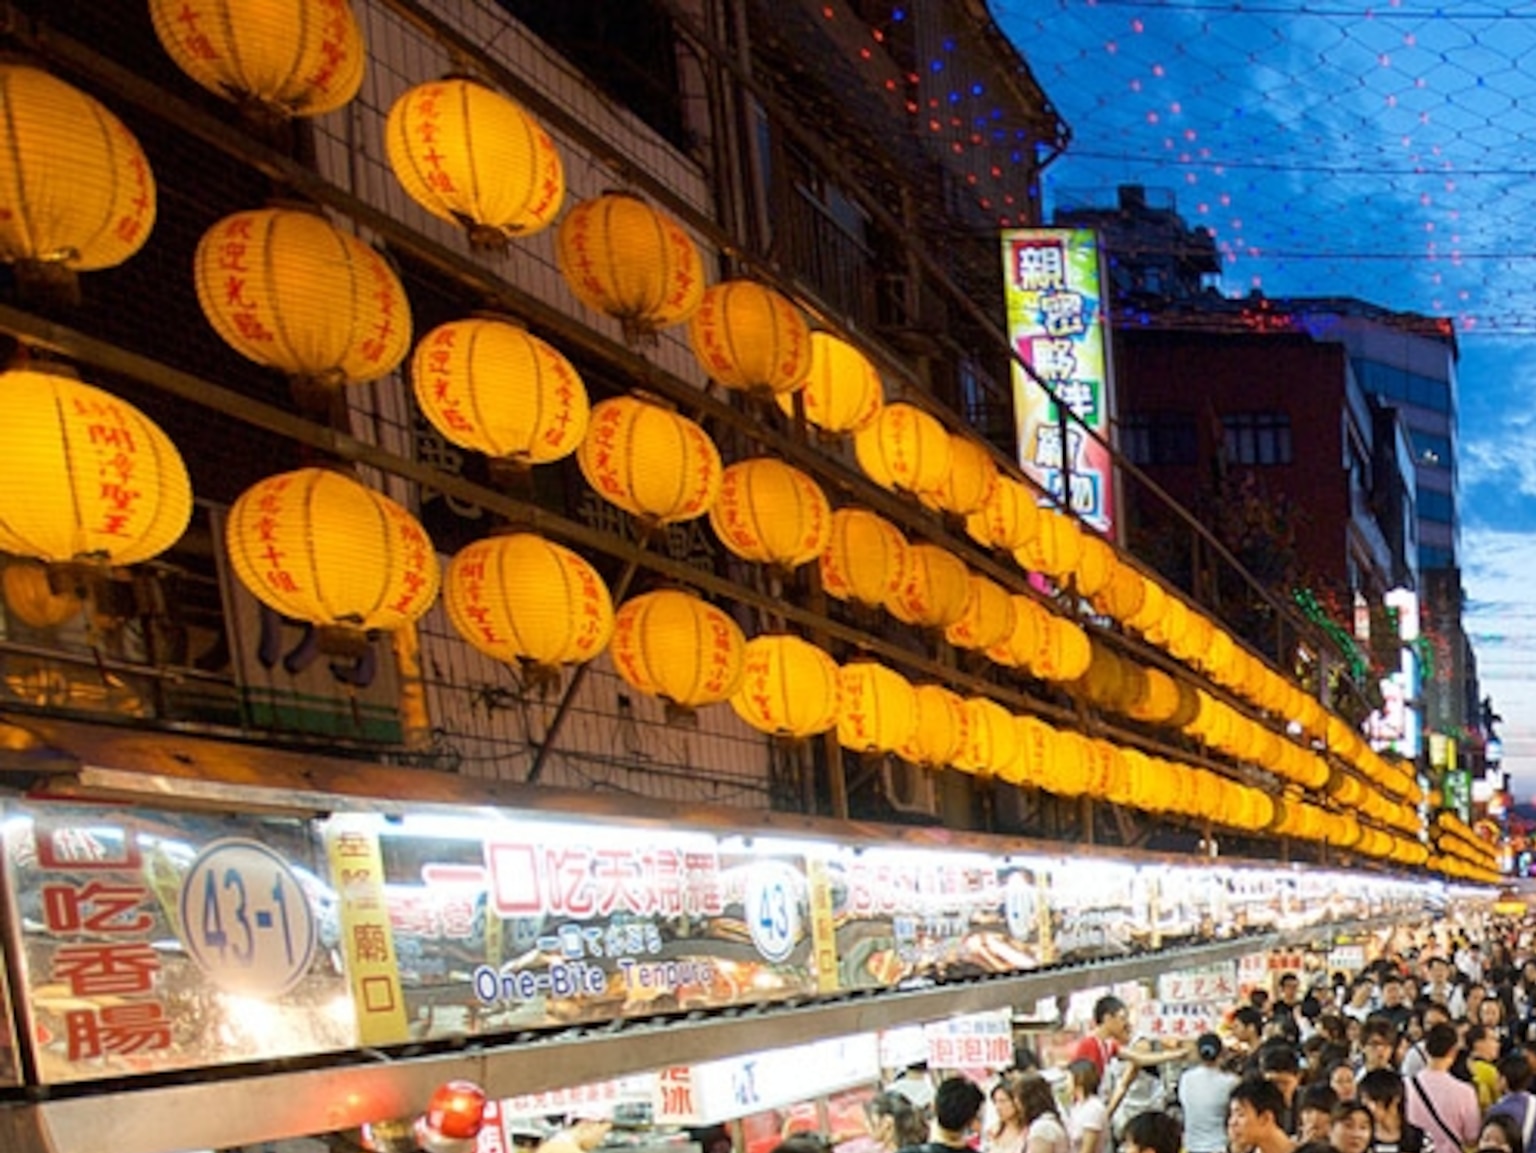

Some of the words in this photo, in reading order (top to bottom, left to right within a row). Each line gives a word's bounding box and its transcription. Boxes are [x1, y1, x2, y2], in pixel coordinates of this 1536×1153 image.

[203, 868, 294, 970] 43-1
[758, 882, 790, 938] 43
[475, 957, 604, 1001] One-Bite
